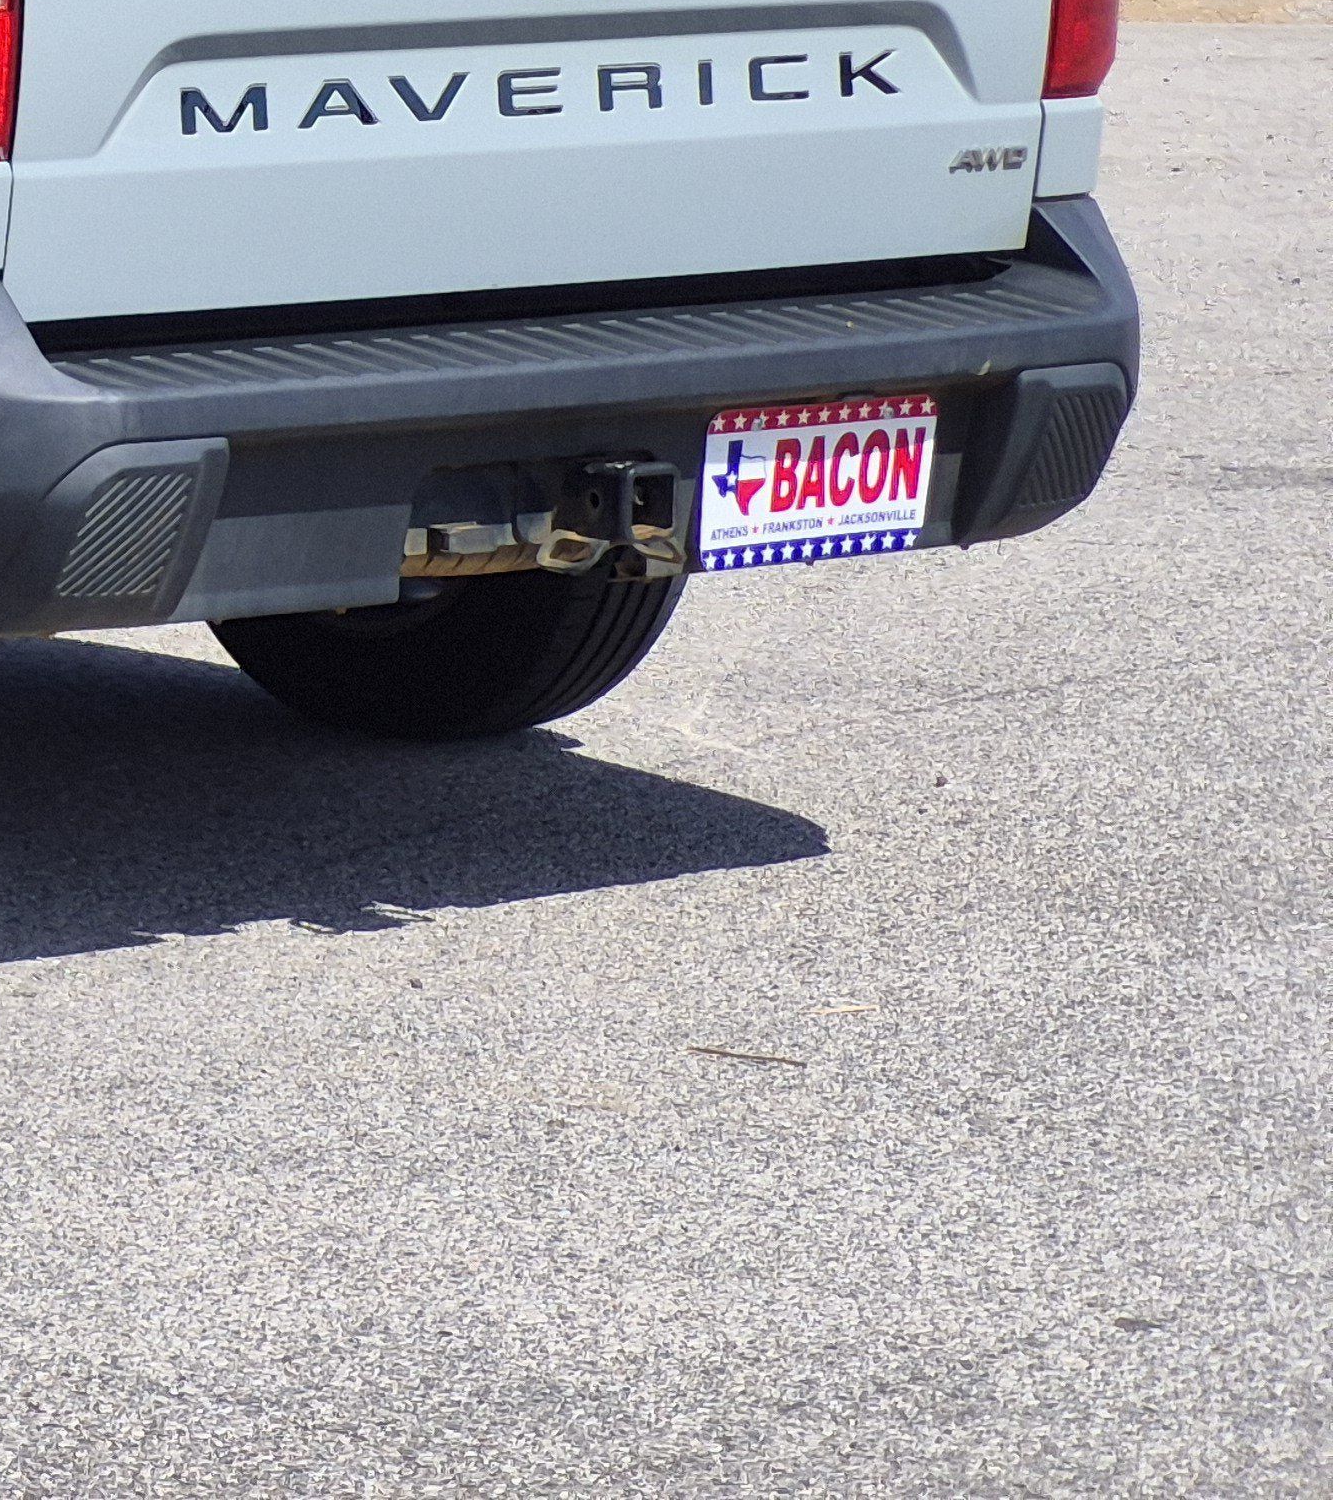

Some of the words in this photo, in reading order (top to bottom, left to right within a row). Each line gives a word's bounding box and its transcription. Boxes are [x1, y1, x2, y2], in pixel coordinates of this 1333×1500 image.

[180, 48, 902, 135] MAVERICK
[948, 146, 1028, 174] AWD
[770, 427, 926, 512] BACON
[710, 524, 749, 540] ATHENS
[762, 516, 823, 535] FRANKSTON
[838, 509, 916, 526] JACKSONVILLE
